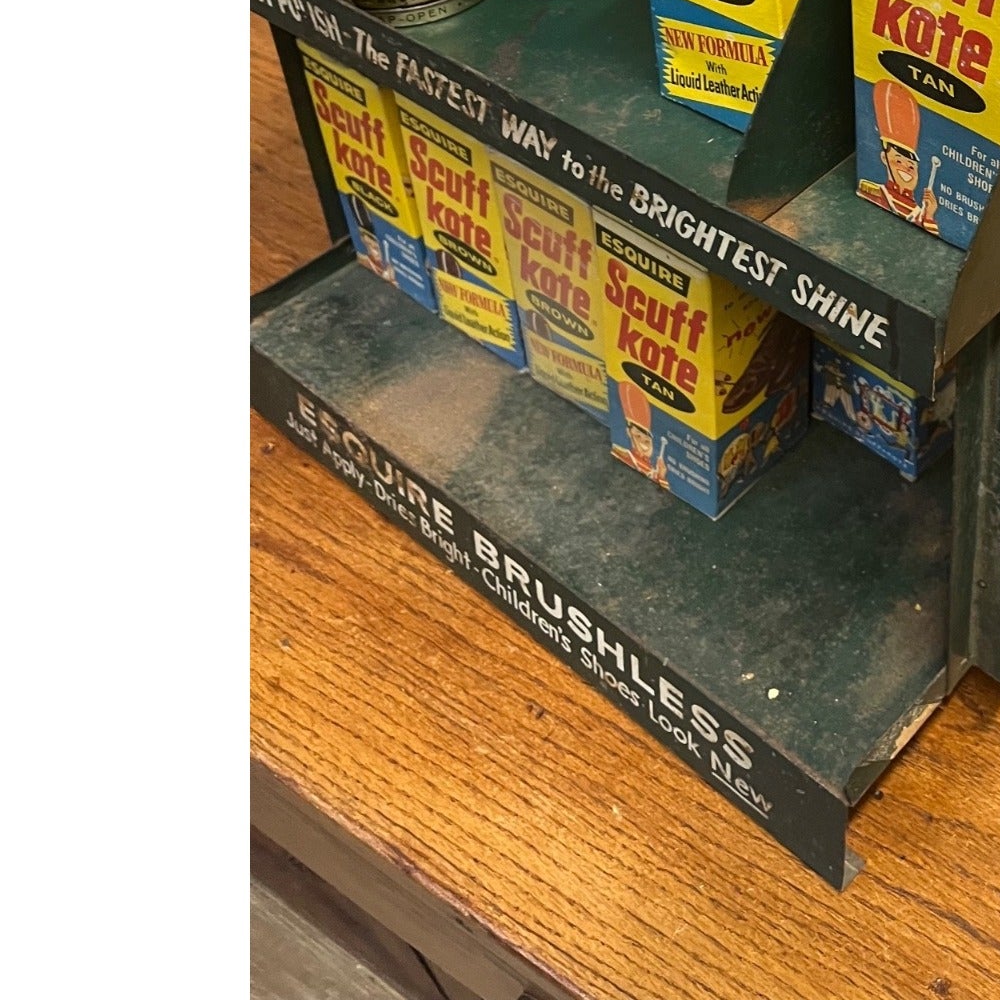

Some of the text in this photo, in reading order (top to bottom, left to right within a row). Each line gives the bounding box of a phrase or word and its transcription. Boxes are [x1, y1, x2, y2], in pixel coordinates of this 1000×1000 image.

[662, 26, 769, 67] NEW FORMULA
[705, 60, 728, 76] With
[304, 58, 364, 103] ESQUIRE
[670, 67, 702, 92] Liquid
[702, 74, 740, 99] Leather
[907, 64, 955, 98] TAN
[312, 79, 385, 159] Scuff
[400, 113, 469, 162] ESQUIRE
[332, 125, 393, 197] kote
[409, 135, 491, 220] Scuff
[971, 145, 988, 162] For
[396, 51, 493, 127] FASTEST
[502, 107, 559, 162] WAY
[562, 150, 585, 180] to
[588, 165, 625, 203] the
[628, 182, 789, 288] BRIGHTEST
[791, 273, 892, 350] SHINE
[494, 170, 570, 221] ESQUIRE
[938, 196, 964, 218] DRIES
[940, 182, 953, 197] NO
[426, 186, 492, 258] kote
[503, 192, 592, 280] Scuff
[437, 233, 493, 274] BROWN
[601, 231, 684, 292] ESQUIRE
[520, 244, 591, 321] kote
[604, 258, 708, 354] Scuff
[531, 295, 589, 338] BROWN
[617, 311, 699, 395] kote
[641, 373, 676, 402] TAN
[297, 392, 755, 771] ESQUIRE BRUSHLESS
[286, 411, 318, 448] Just
[580, 647, 641, 708] Shoes
[648, 698, 703, 760] Look
[711, 750, 774, 814] New
